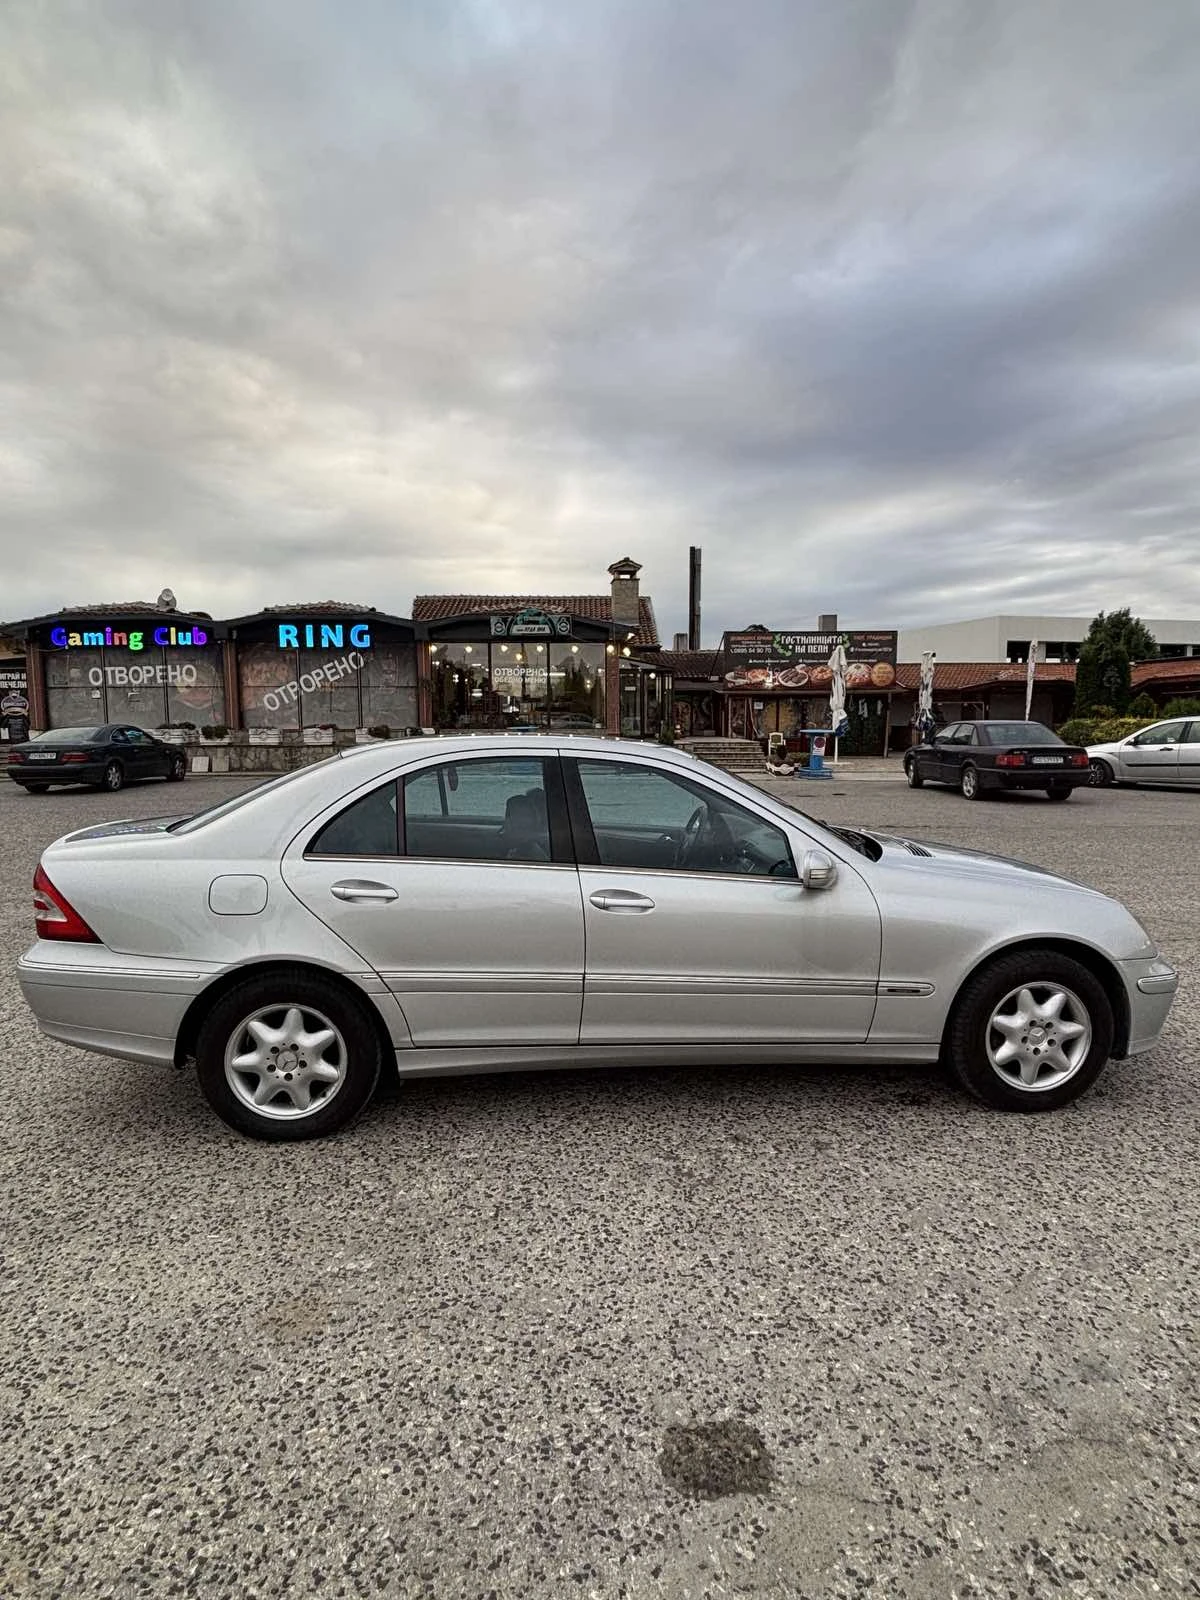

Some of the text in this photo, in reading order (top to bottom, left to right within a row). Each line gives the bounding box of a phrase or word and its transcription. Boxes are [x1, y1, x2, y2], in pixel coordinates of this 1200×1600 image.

[51, 627, 208, 650] Gaming Club
[278, 624, 371, 648] RING
[795, 645, 806, 653] НА
[88, 664, 198, 686] ОТВОРЕНО
[494, 667, 546, 677] ОТВОРЕНО
